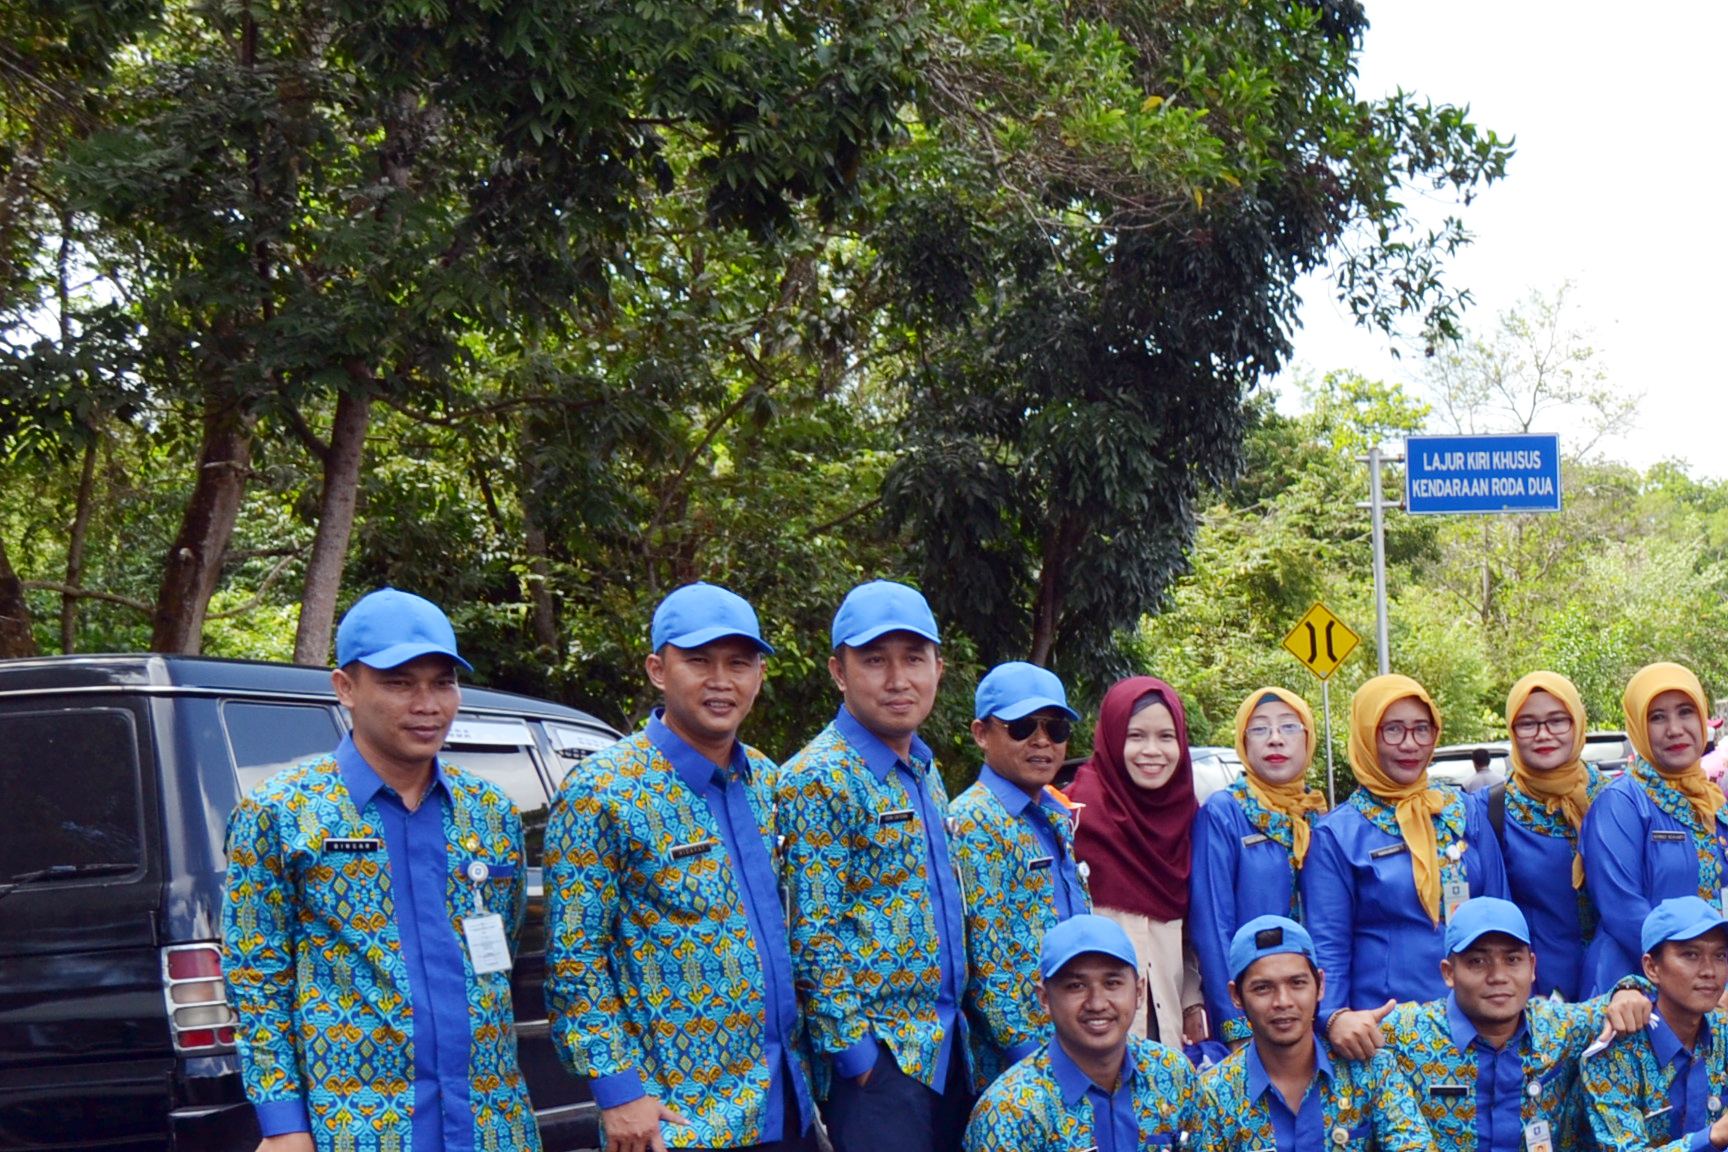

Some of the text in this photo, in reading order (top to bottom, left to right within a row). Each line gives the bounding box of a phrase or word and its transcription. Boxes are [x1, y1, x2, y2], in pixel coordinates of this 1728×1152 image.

[1423, 450, 1541, 471] LAJUR KIRI KHUSUS
[1412, 476, 1554, 497] KENDARAAN RODA DUA
